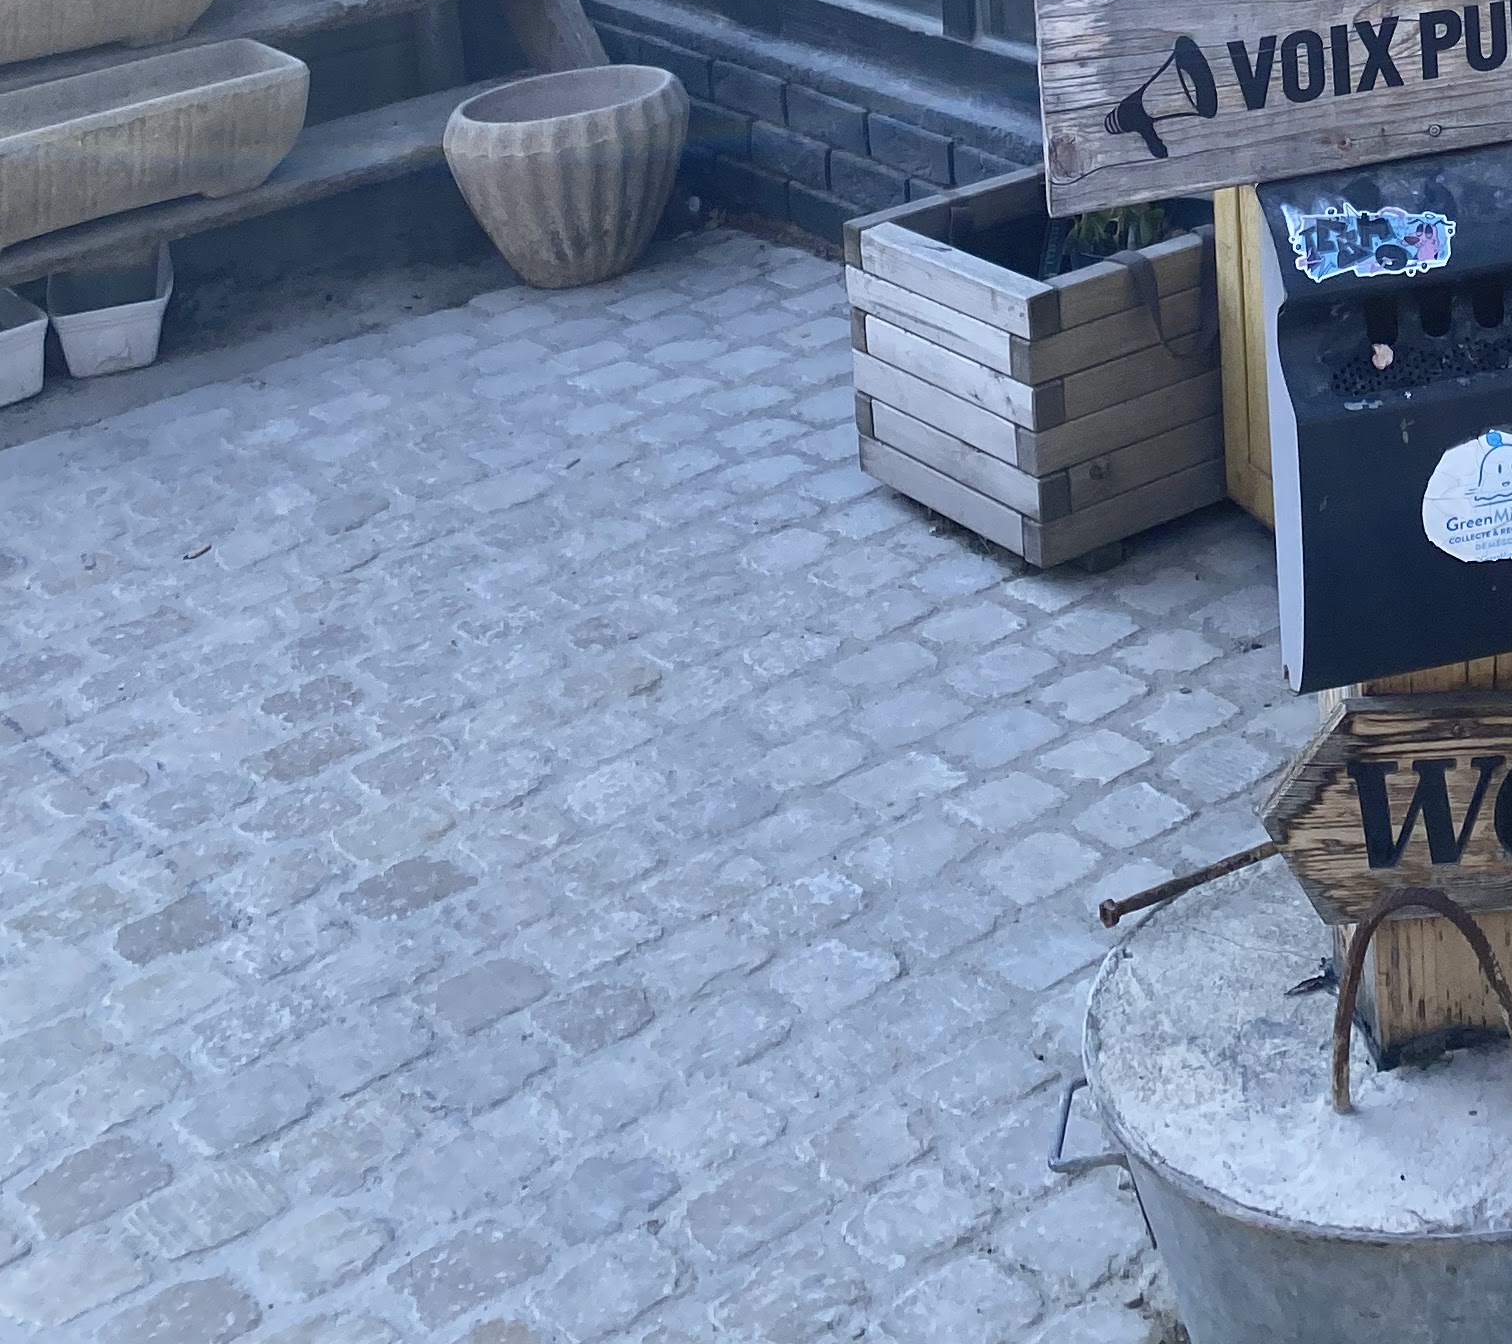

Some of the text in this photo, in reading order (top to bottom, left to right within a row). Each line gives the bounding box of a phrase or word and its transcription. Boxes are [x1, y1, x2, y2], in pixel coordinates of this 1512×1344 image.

[1227, 16, 1405, 111] VOIX
[1449, 530, 1491, 545] COLLECTE
[1475, 540, 1486, 550] DE
